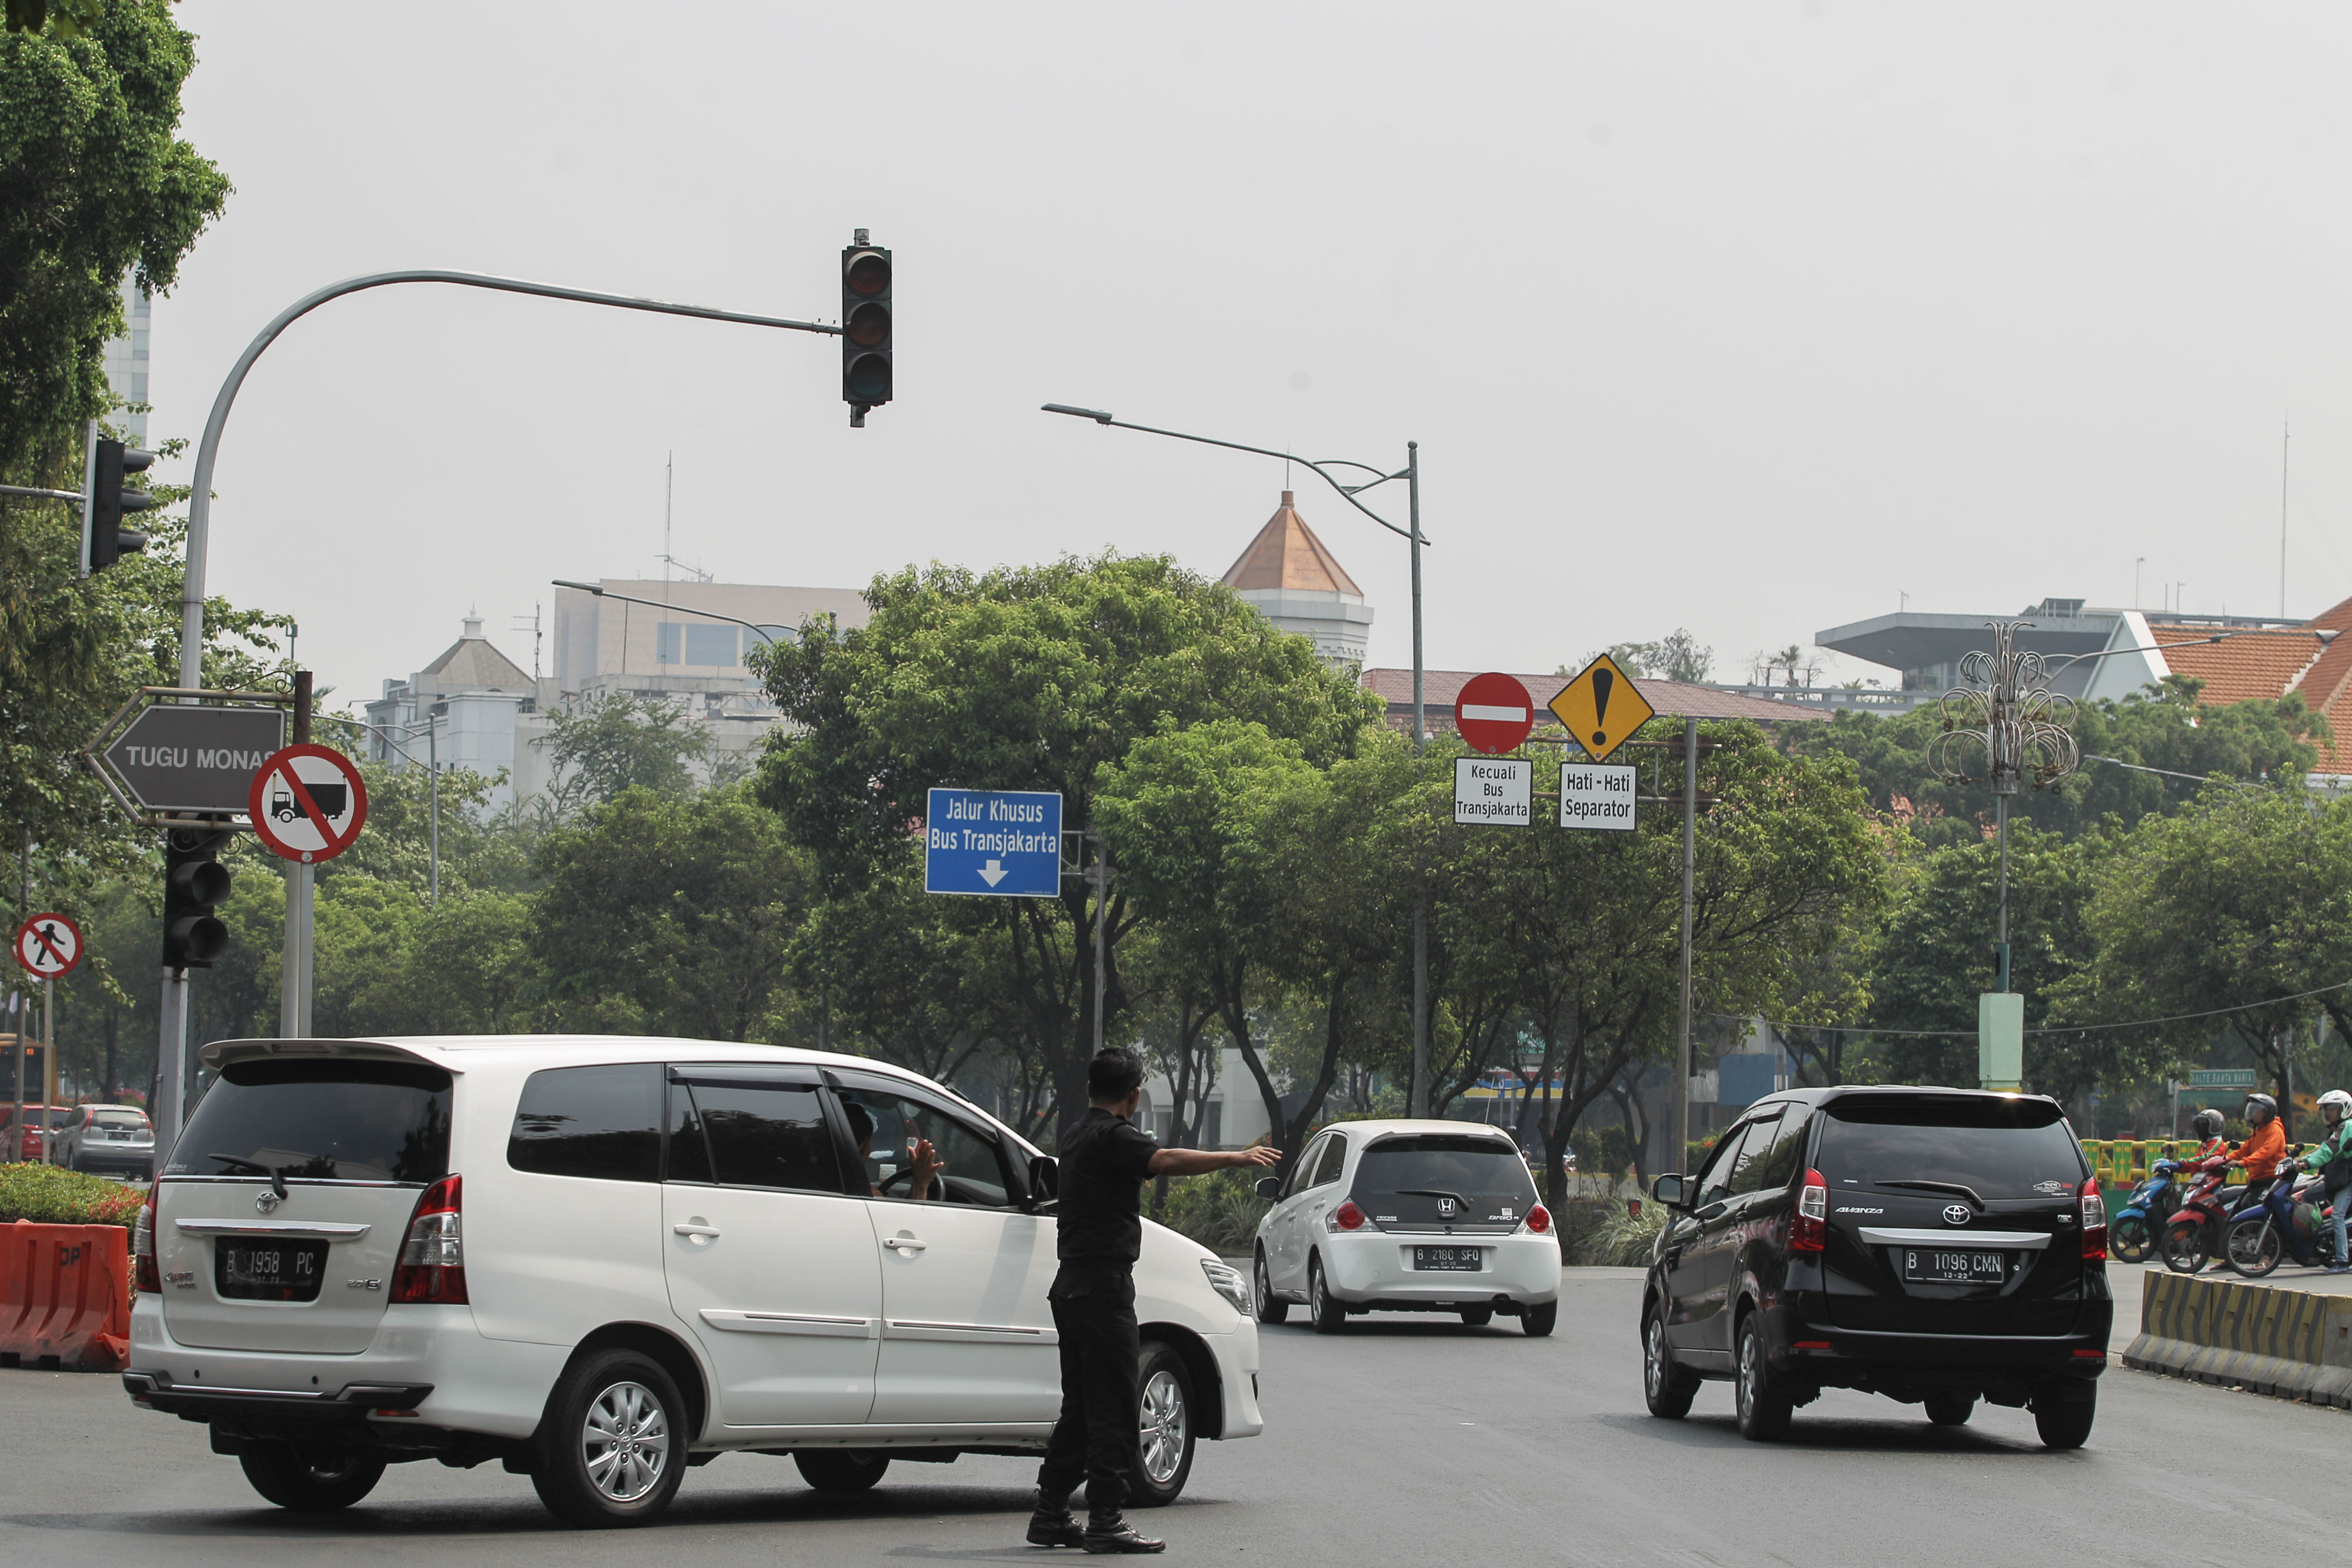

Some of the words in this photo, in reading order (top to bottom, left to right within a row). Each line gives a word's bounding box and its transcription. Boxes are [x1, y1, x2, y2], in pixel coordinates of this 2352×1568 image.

[126, 746, 188, 768] TUGU
[1472, 765, 1515, 780] Kecuali
[1567, 773, 1592, 790] Hati
[1605, 774, 1629, 792] Hati
[1484, 783, 1503, 797] Bus
[946, 797, 983, 820] Jalur
[990, 799, 1043, 823] Khusus
[1457, 801, 1527, 818] Transjakarta
[1566, 798, 1630, 820] Separator
[931, 828, 957, 850] Bus
[963, 828, 1056, 857] Transjakarta
[227, 1251, 235, 1272] B
[250, 1252, 280, 1273] 1958
[296, 1252, 314, 1274] PC
[1418, 1249, 1424, 1260] B
[1461, 1249, 1478, 1261] SFQ
[1908, 1252, 1917, 1269] B
[1935, 1253, 1967, 1271] 1096
[1973, 1255, 2001, 1272] CMN
